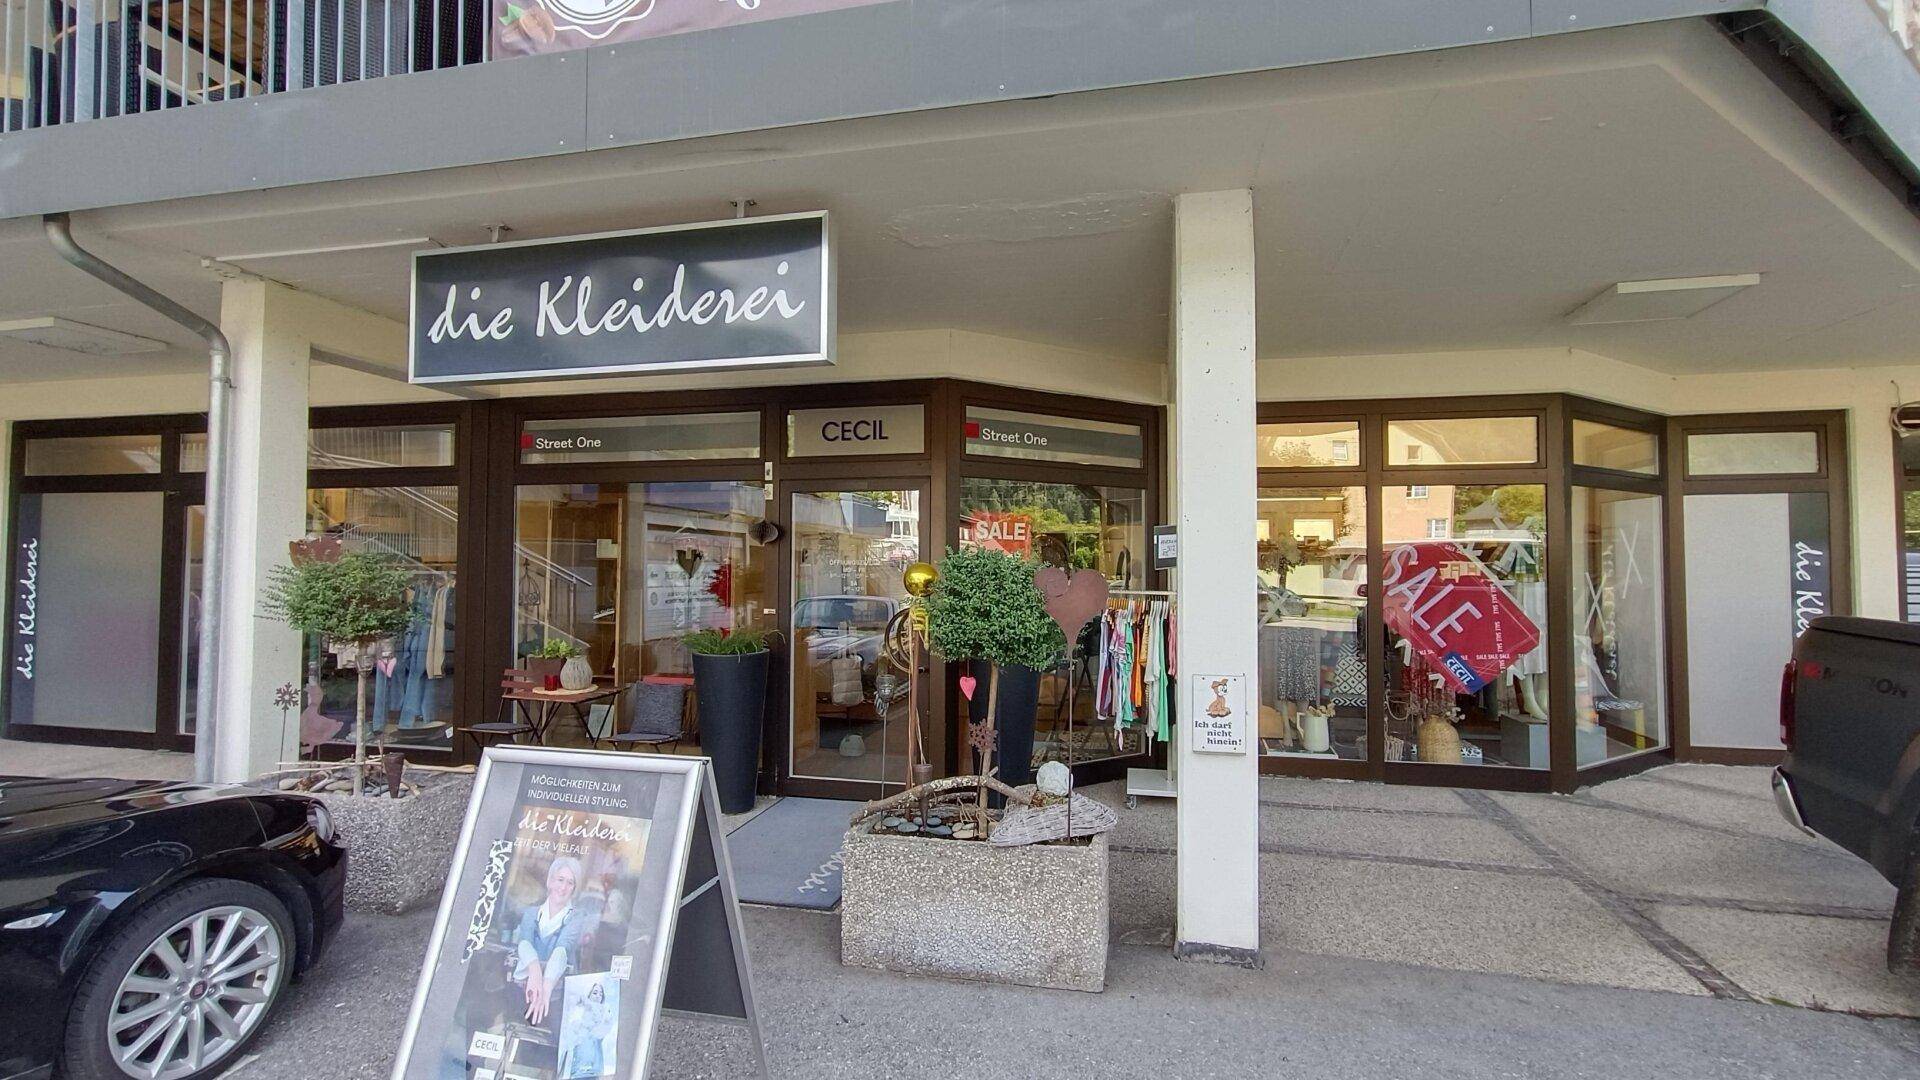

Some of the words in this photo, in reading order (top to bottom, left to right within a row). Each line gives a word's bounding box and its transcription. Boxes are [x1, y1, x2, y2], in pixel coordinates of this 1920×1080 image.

[427, 284, 514, 344] die
[536, 261, 806, 338] Kleiderei
[821, 420, 889, 441] CECIL
[982, 428, 1020, 444] Street
[1024, 432, 1048, 446] One
[535, 437, 574, 449] Street
[576, 436, 602, 448] One
[975, 520, 1026, 541] SALE
[1795, 541, 1824, 581] die
[18, 537, 39, 636] Kleiderei
[1383, 545, 1482, 648] SALE
[16, 643, 35, 680] die
[1445, 658, 1473, 686] CECIL
[1207, 738, 1241, 746] hinein!
[531, 775, 600, 791] MÖGLICHKEITEN
[601, 782, 622, 793] ZUM
[527, 789, 592, 804] INDIVIDUELLEN
[591, 795, 630, 809] STYLING.
[518, 809, 549, 832] die
[552, 813, 632, 842] Kleiderei
[532, 839, 551, 850] DER
[474, 1039, 499, 1053] CECIL
